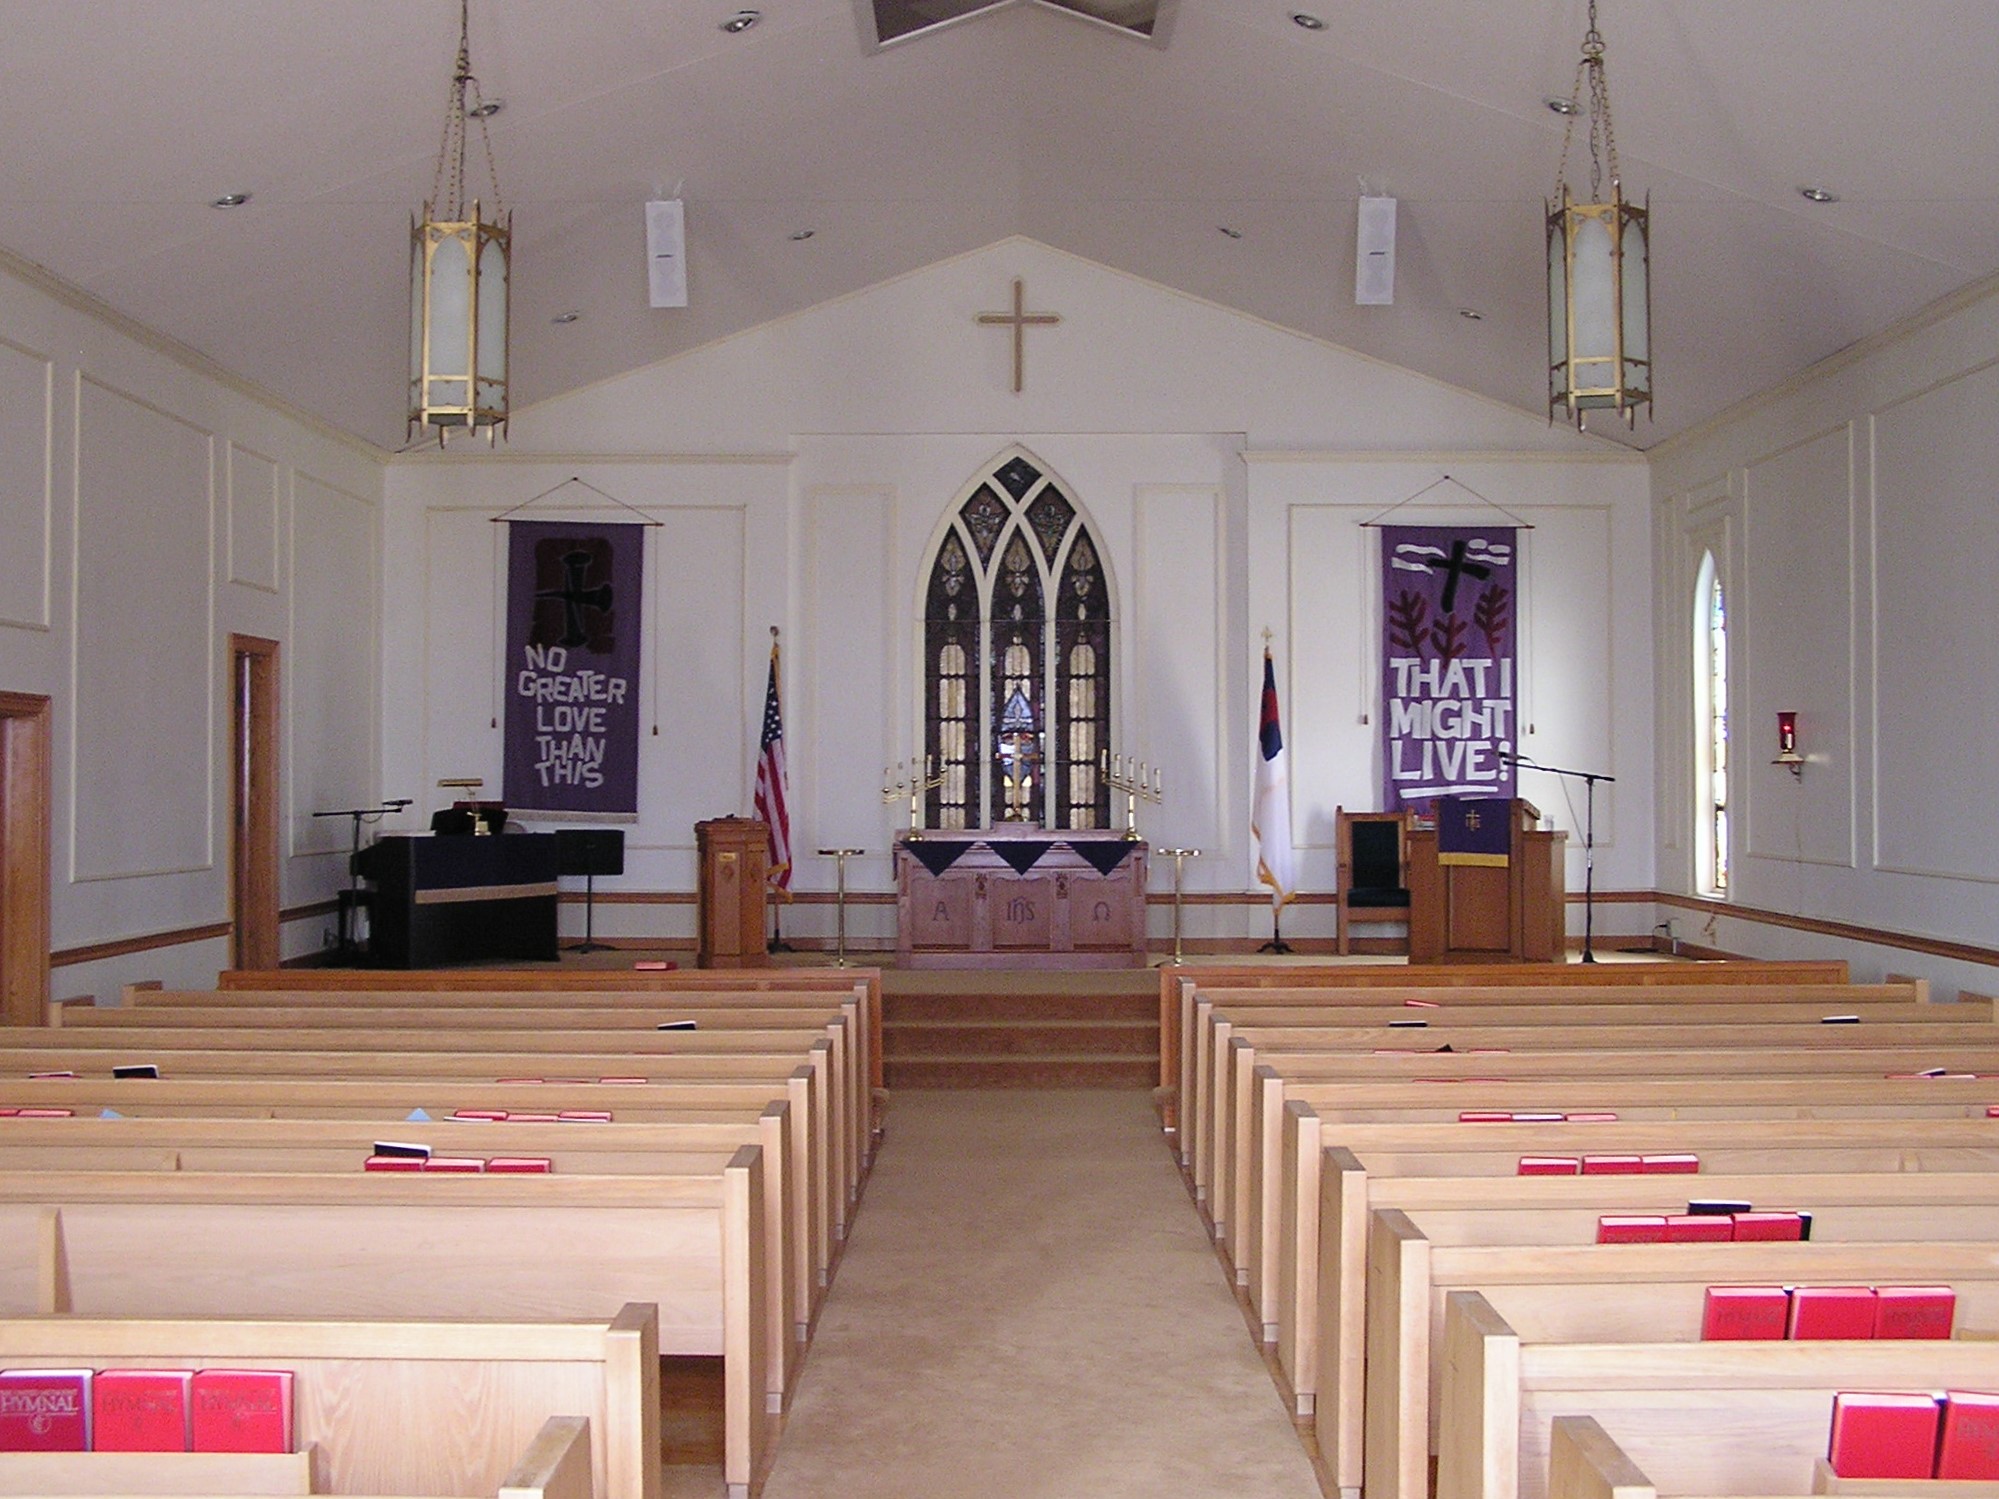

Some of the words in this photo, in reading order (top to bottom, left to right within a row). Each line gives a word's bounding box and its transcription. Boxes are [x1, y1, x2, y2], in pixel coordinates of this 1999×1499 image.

[524, 643, 568, 673] NO
[518, 670, 628, 705] GREATER
[1389, 657, 1493, 698] THAT
[1500, 657, 1511, 698] I
[536, 705, 608, 733] LOVE
[1389, 698, 1512, 739] MIGHT
[534, 733, 606, 766] THAN
[1391, 740, 1511, 782] LIVE!
[534, 759, 605, 788] THIS
[1, 1394, 79, 1412] HYMNAL
